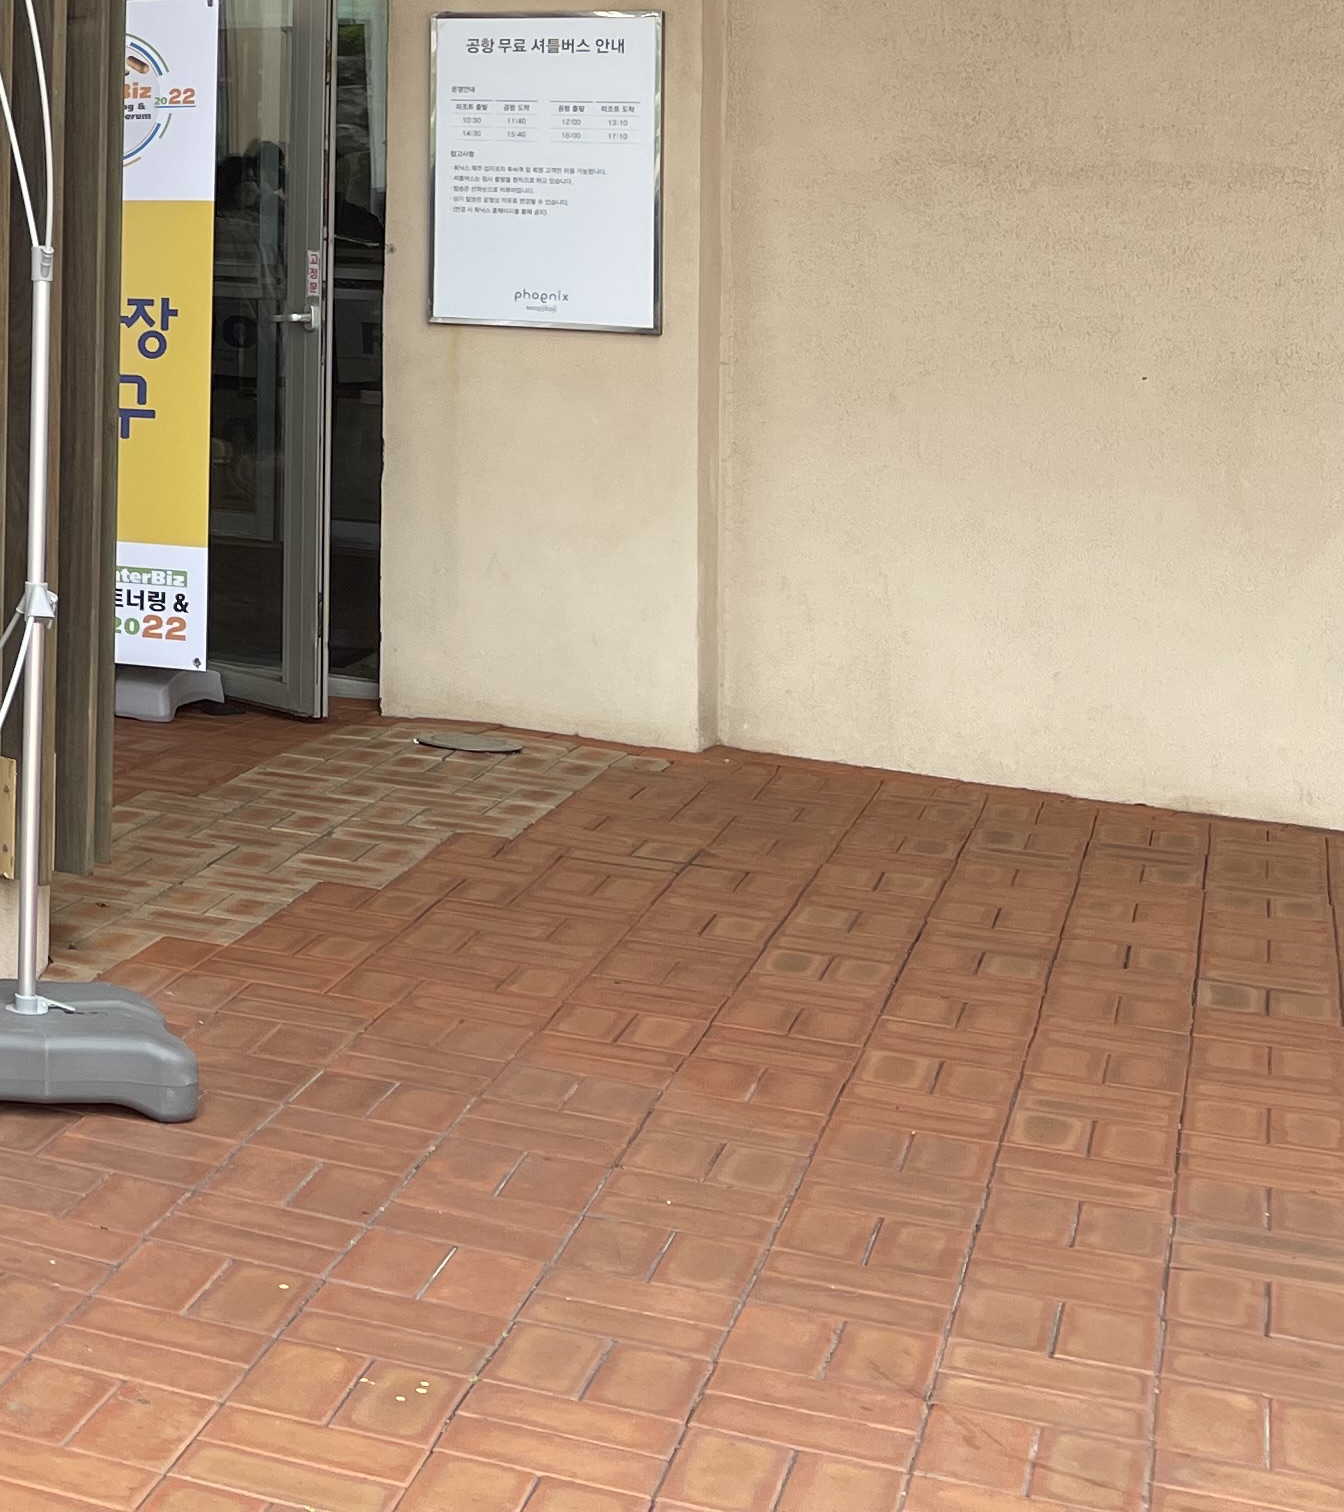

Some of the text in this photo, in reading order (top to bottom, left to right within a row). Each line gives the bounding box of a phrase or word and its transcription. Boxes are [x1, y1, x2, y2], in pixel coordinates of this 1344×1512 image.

[466, 38, 625, 54] 공항 무료 셔틀버스 안내
[154, 88, 196, 105] 2022
[514, 288, 569, 304] phoenix
[121, 296, 179, 359] 장
[173, 593, 189, 614] &
